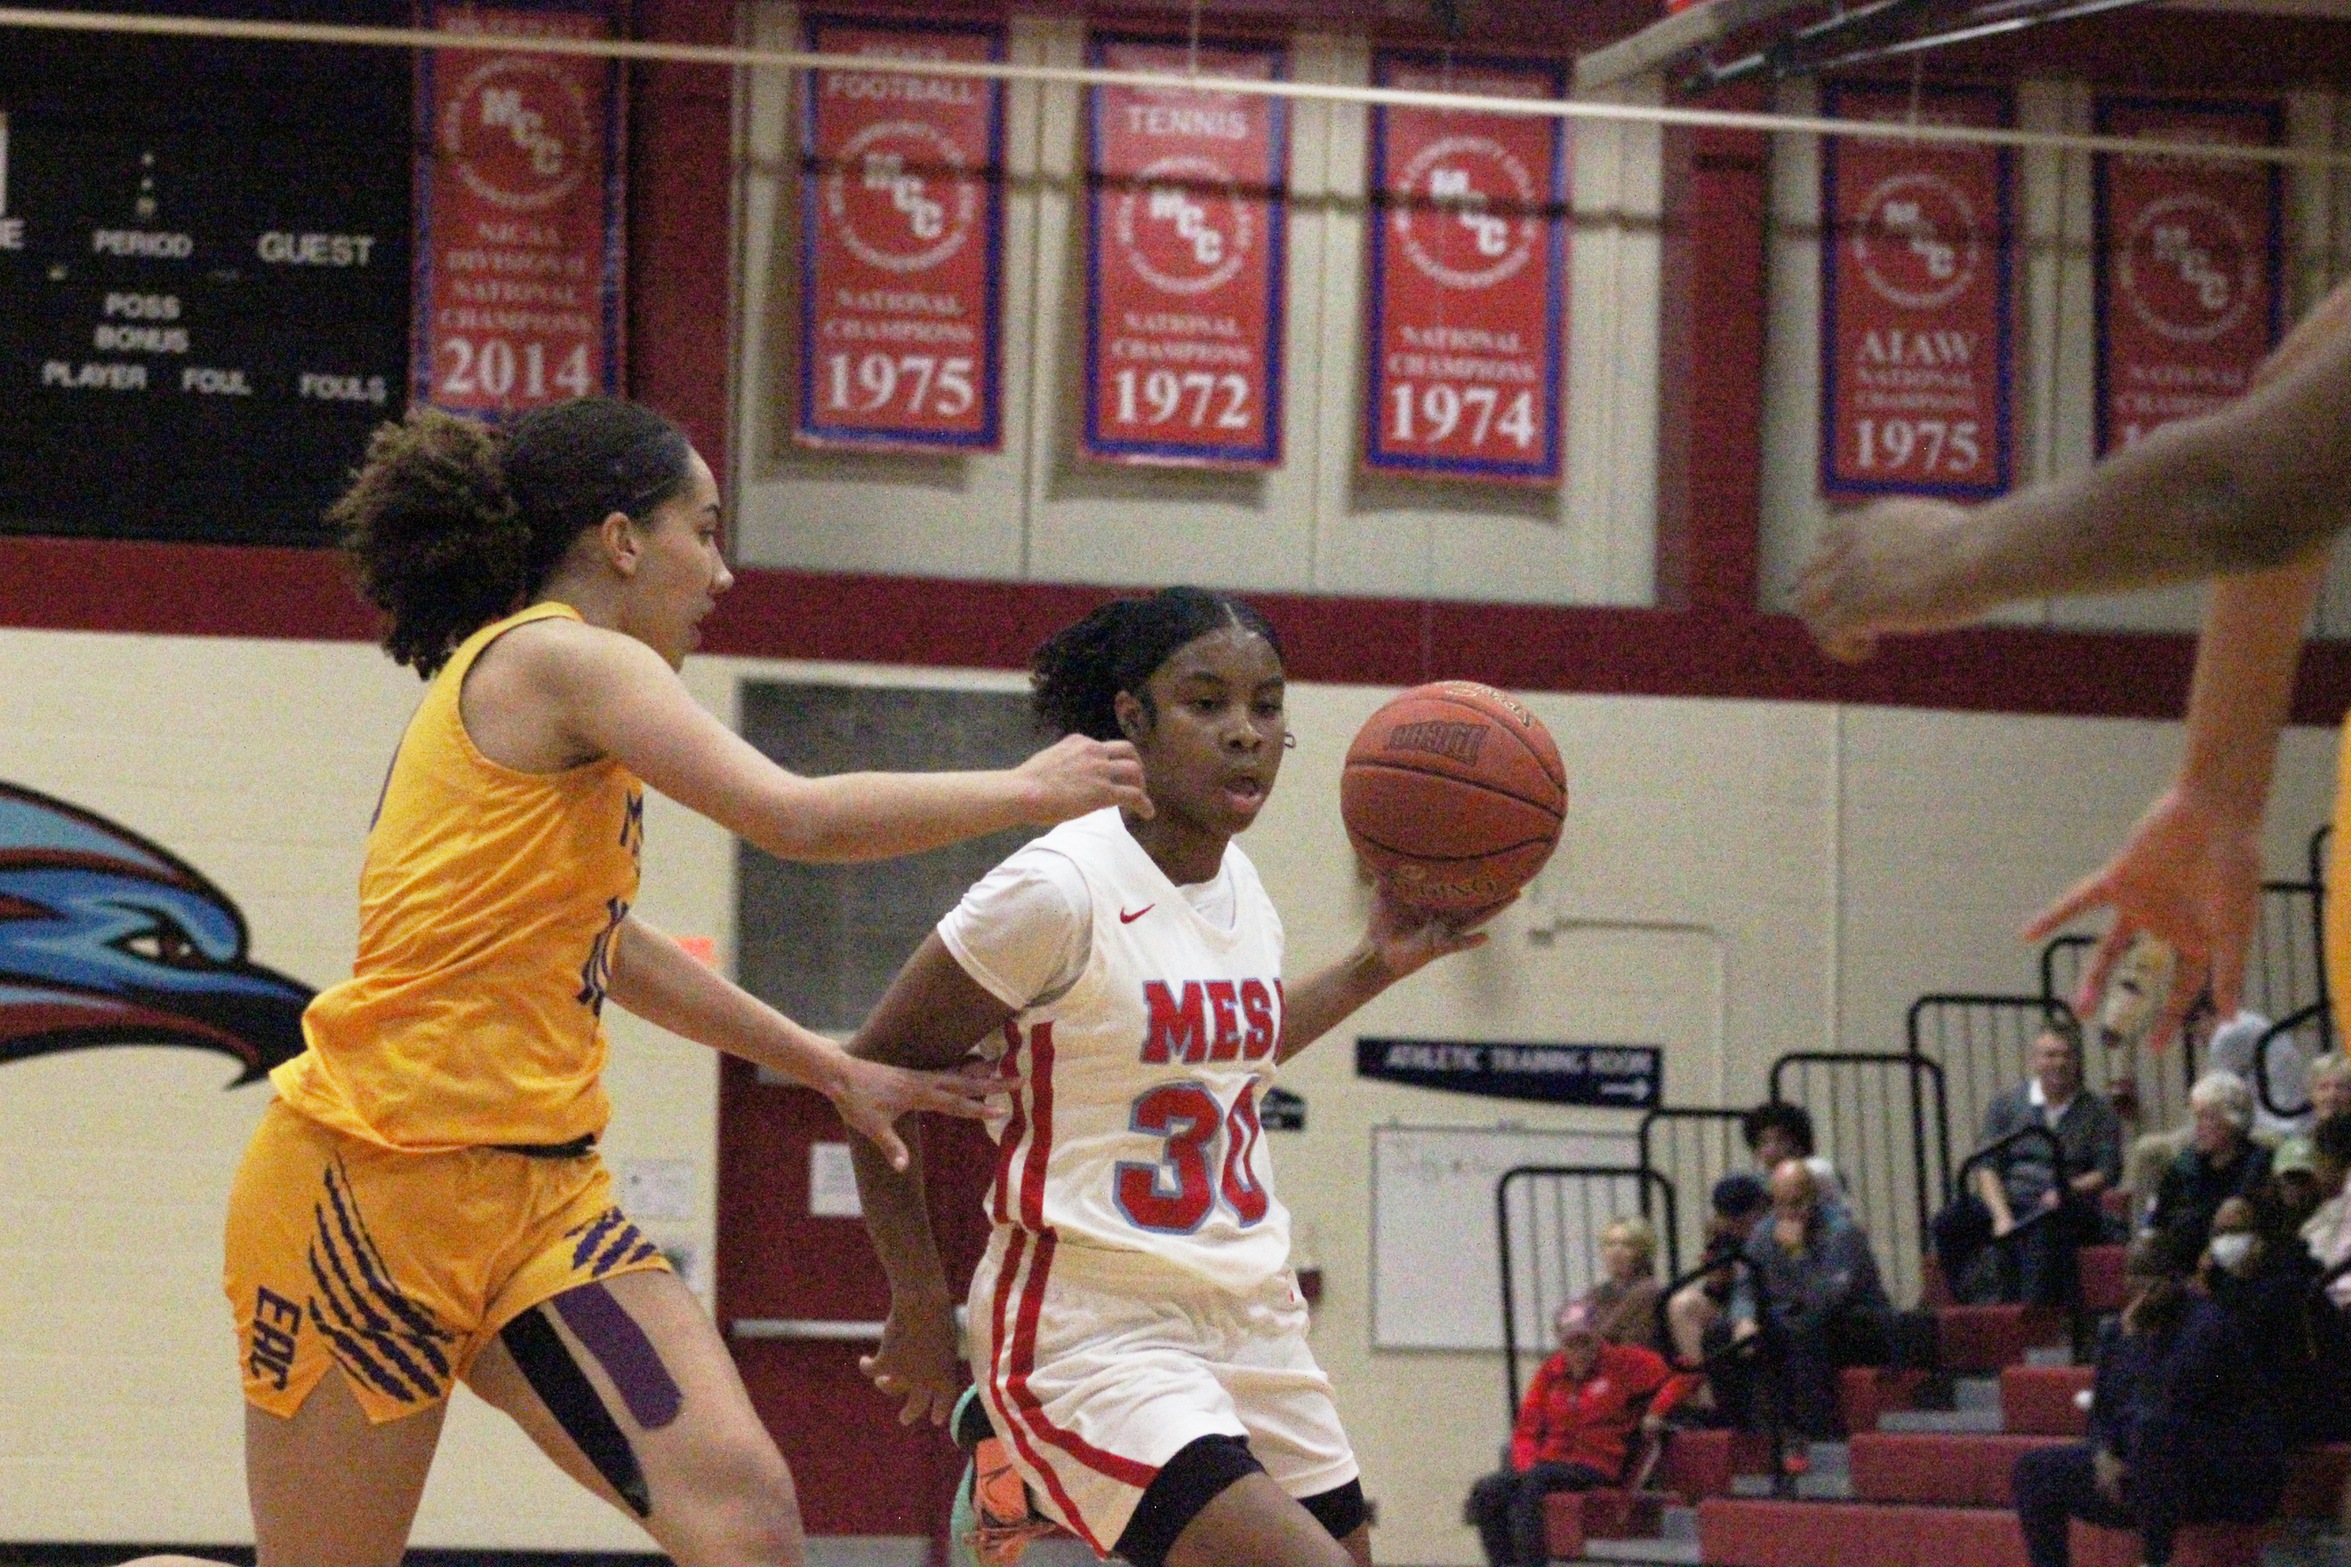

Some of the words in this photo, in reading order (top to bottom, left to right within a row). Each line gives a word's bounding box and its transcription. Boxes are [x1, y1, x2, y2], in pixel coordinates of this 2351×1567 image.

[827, 74, 973, 104] FOOTBALL
[1126, 105, 1249, 139] TENNIS
[865, 152, 944, 239] MCC
[1149, 188, 1223, 265] MCC
[93, 229, 194, 258] PERIOD
[257, 231, 376, 267] GUEST
[104, 292, 181, 319] POSS
[452, 280, 576, 302] NATIONAL
[836, 288, 968, 316] NATIONAL
[439, 307, 594, 332] CHAMPIONS
[822, 319, 975, 344] CHAMPIONS
[1123, 312, 1241, 338] NATIONAL
[94, 325, 190, 354] BONUS
[1111, 337, 1253, 363] CHAMPIONS
[1401, 325, 1521, 353] NATIONAL
[1858, 329, 1978, 365] AIAW
[42, 360, 148, 390] PLAYER
[182, 366, 253, 395] FOUL
[300, 373, 387, 404] FOULS
[442, 337, 593, 397] 2014
[1387, 353, 1537, 381] CHAMPIONS
[1858, 368, 1973, 388] NATIONAL
[827, 352, 975, 416] 1975
[1113, 369, 1252, 429] 1972
[1855, 389, 1978, 410] CHAMPIONS
[1390, 382, 1535, 448] 1974
[1855, 418, 1980, 473] 1975
[1140, 977, 1288, 1064] MES
[1384, 1043, 1482, 1072] ATHLETIC
[1491, 1047, 1587, 1074] TRAINING
[1589, 1050, 1652, 1075] ROOM
[1112, 1077, 1270, 1236] 30
